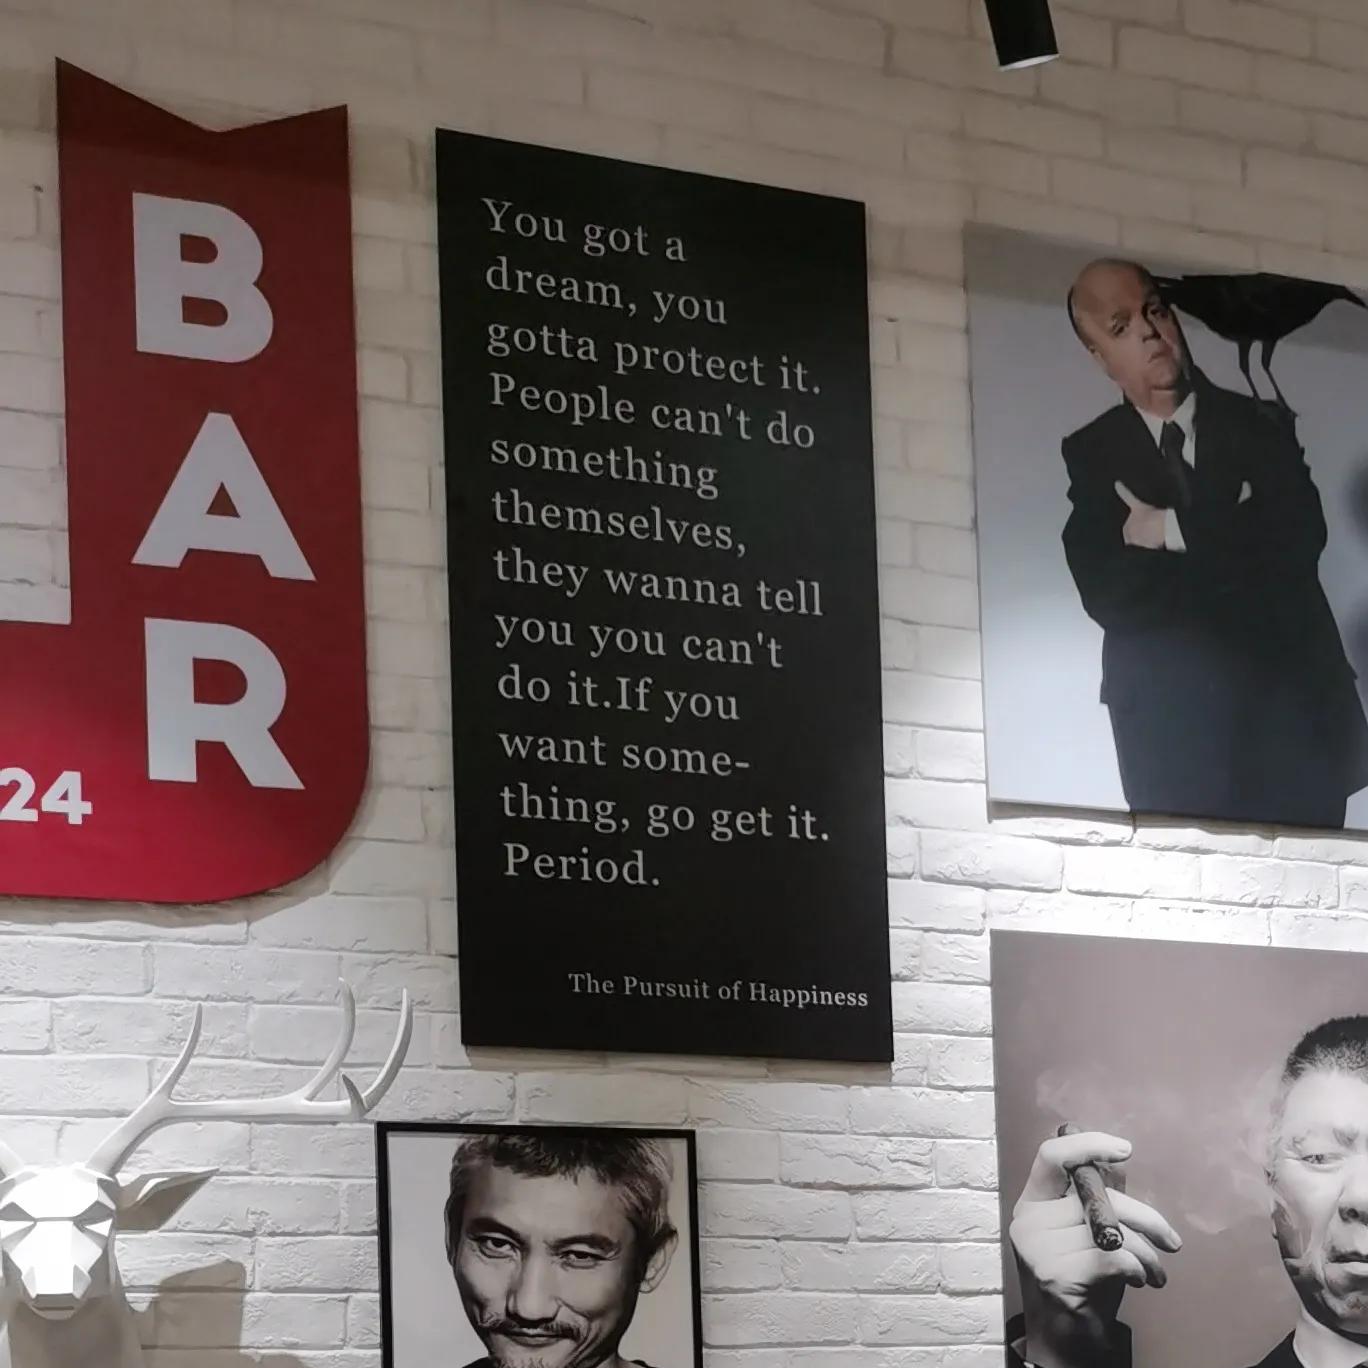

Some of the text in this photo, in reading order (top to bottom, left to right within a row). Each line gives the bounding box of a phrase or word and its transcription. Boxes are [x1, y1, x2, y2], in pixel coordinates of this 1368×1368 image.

[482, 198, 685, 262] You got a
[486, 255, 727, 324] dream, you
[487, 323, 820, 395] gotta protect it.
[490, 372, 815, 449] People can't do
[491, 439, 719, 500] something
[491, 488, 746, 558] themselves,
[493, 546, 823, 616] they wanna tell
[494, 614, 783, 668] you you can't
[497, 663, 551, 702] do
[663, 690, 740, 723] you
[498, 733, 750, 777] want some-
[499, 782, 829, 842] thing, go get it.
[503, 842, 660, 886] Period.
[569, 973, 868, 1008] The Pursuit of Happiness
